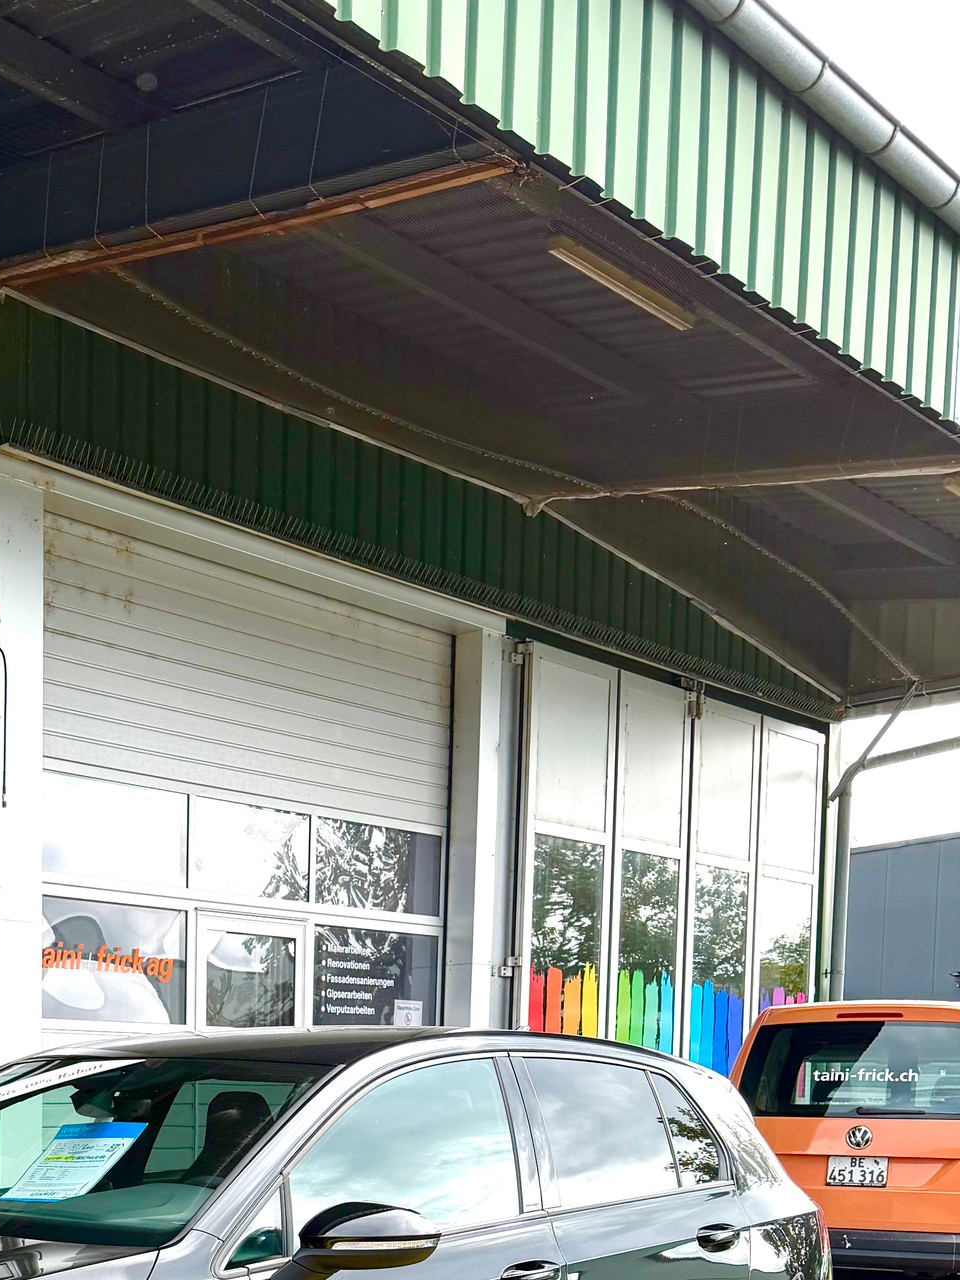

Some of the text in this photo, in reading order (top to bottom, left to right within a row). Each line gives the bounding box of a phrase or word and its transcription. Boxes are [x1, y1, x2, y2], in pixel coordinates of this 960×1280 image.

[327, 958, 371, 971] Renovationen
[326, 973, 395, 988] Fassadensanierungen
[326, 989, 373, 1001] Gipserarbeiten
[326, 1003, 376, 1016] Verputzarbeiten
[813, 1068, 919, 1082] taini-frick.ch
[850, 1157, 865, 1168] BE
